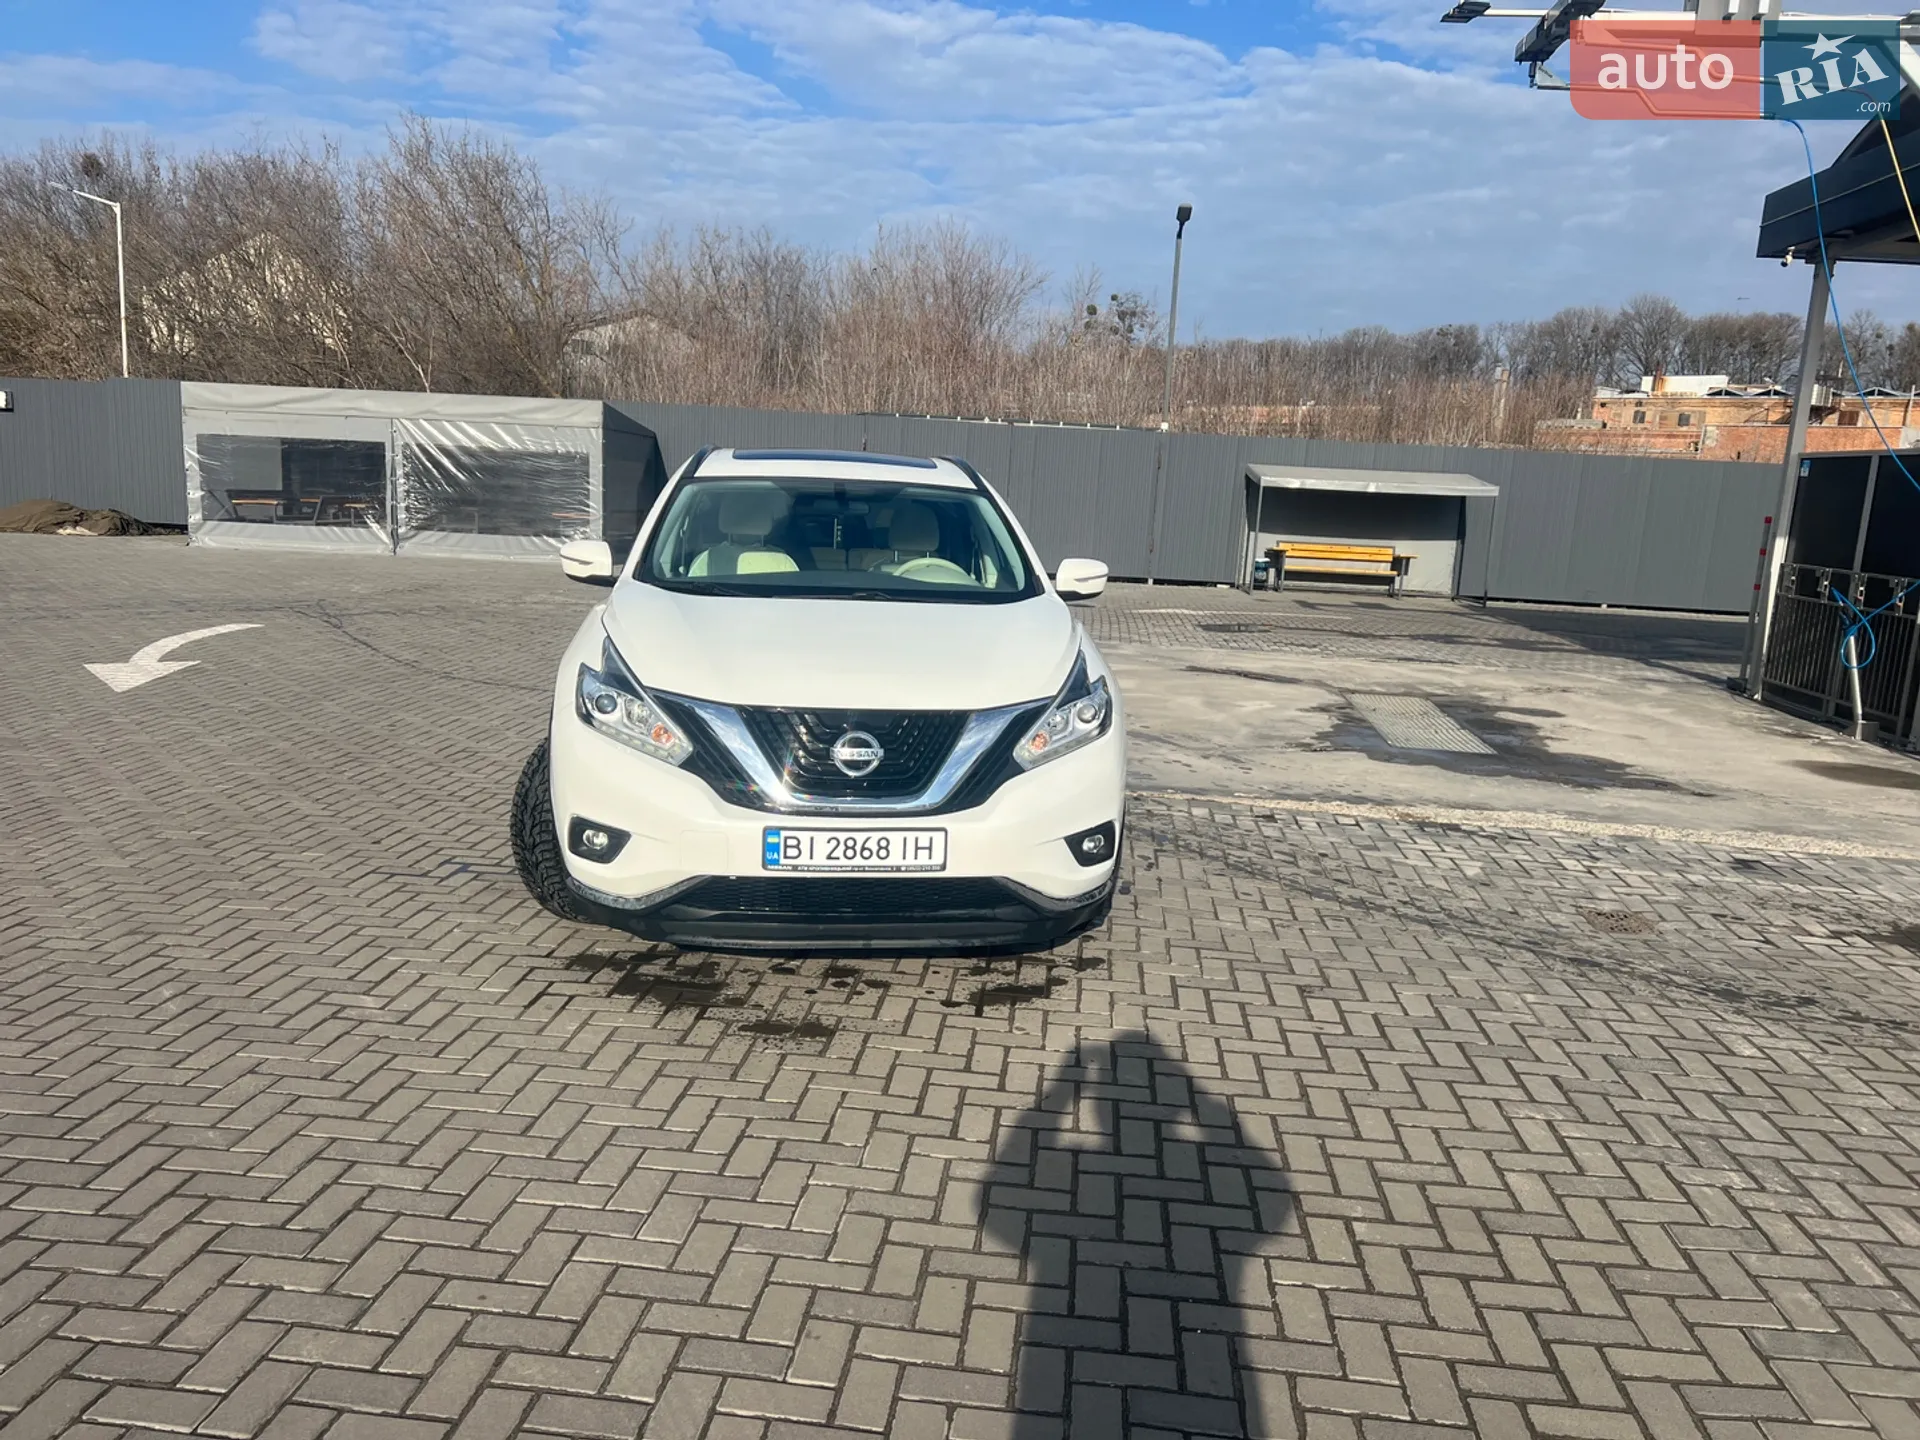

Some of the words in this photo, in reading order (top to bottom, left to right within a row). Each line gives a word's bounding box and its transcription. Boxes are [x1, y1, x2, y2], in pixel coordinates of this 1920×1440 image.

[836, 750, 879, 758] NISSAN
[783, 836, 814, 860] BI
[825, 836, 891, 860] 2868
[902, 836, 933, 860] IH
[766, 851, 779, 860] UA
